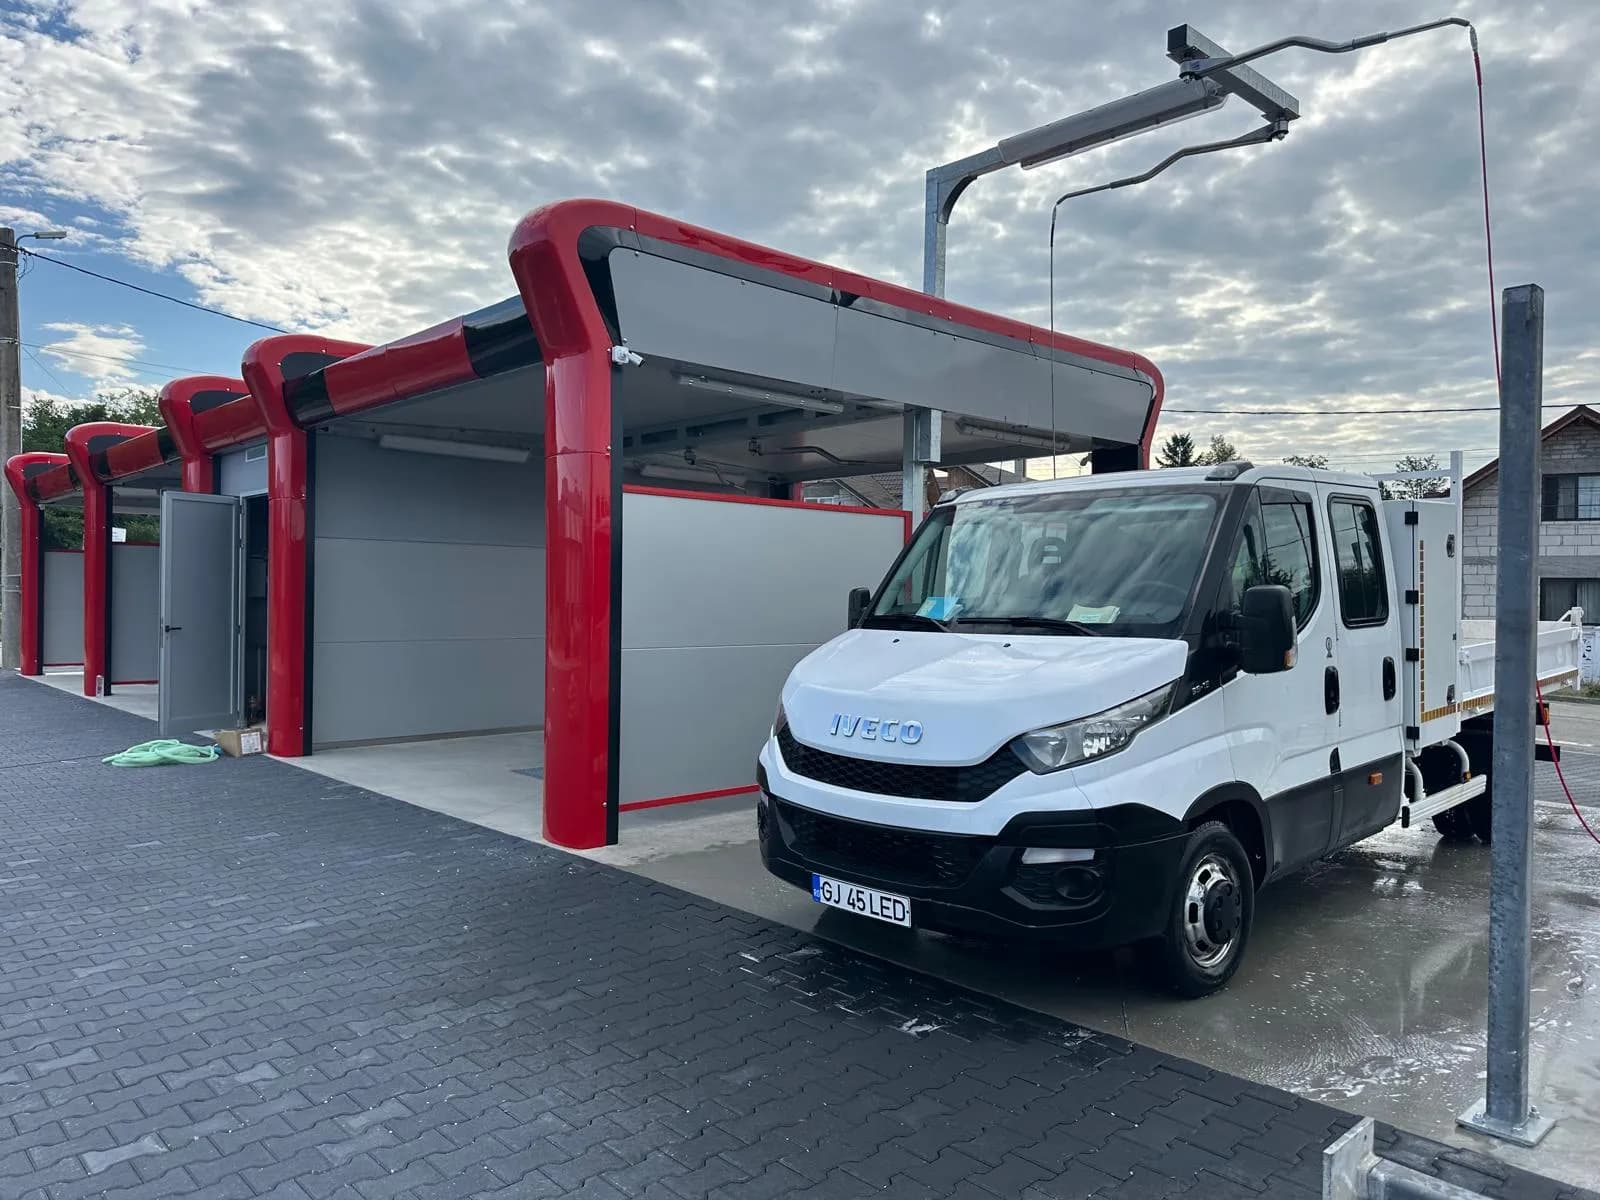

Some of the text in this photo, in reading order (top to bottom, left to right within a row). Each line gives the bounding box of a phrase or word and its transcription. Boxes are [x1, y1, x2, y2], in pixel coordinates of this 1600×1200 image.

[830, 713, 923, 744] IVECO
[822, 881, 840, 904] GJ
[847, 888, 865, 911] 45
[869, 893, 905, 921] LED
